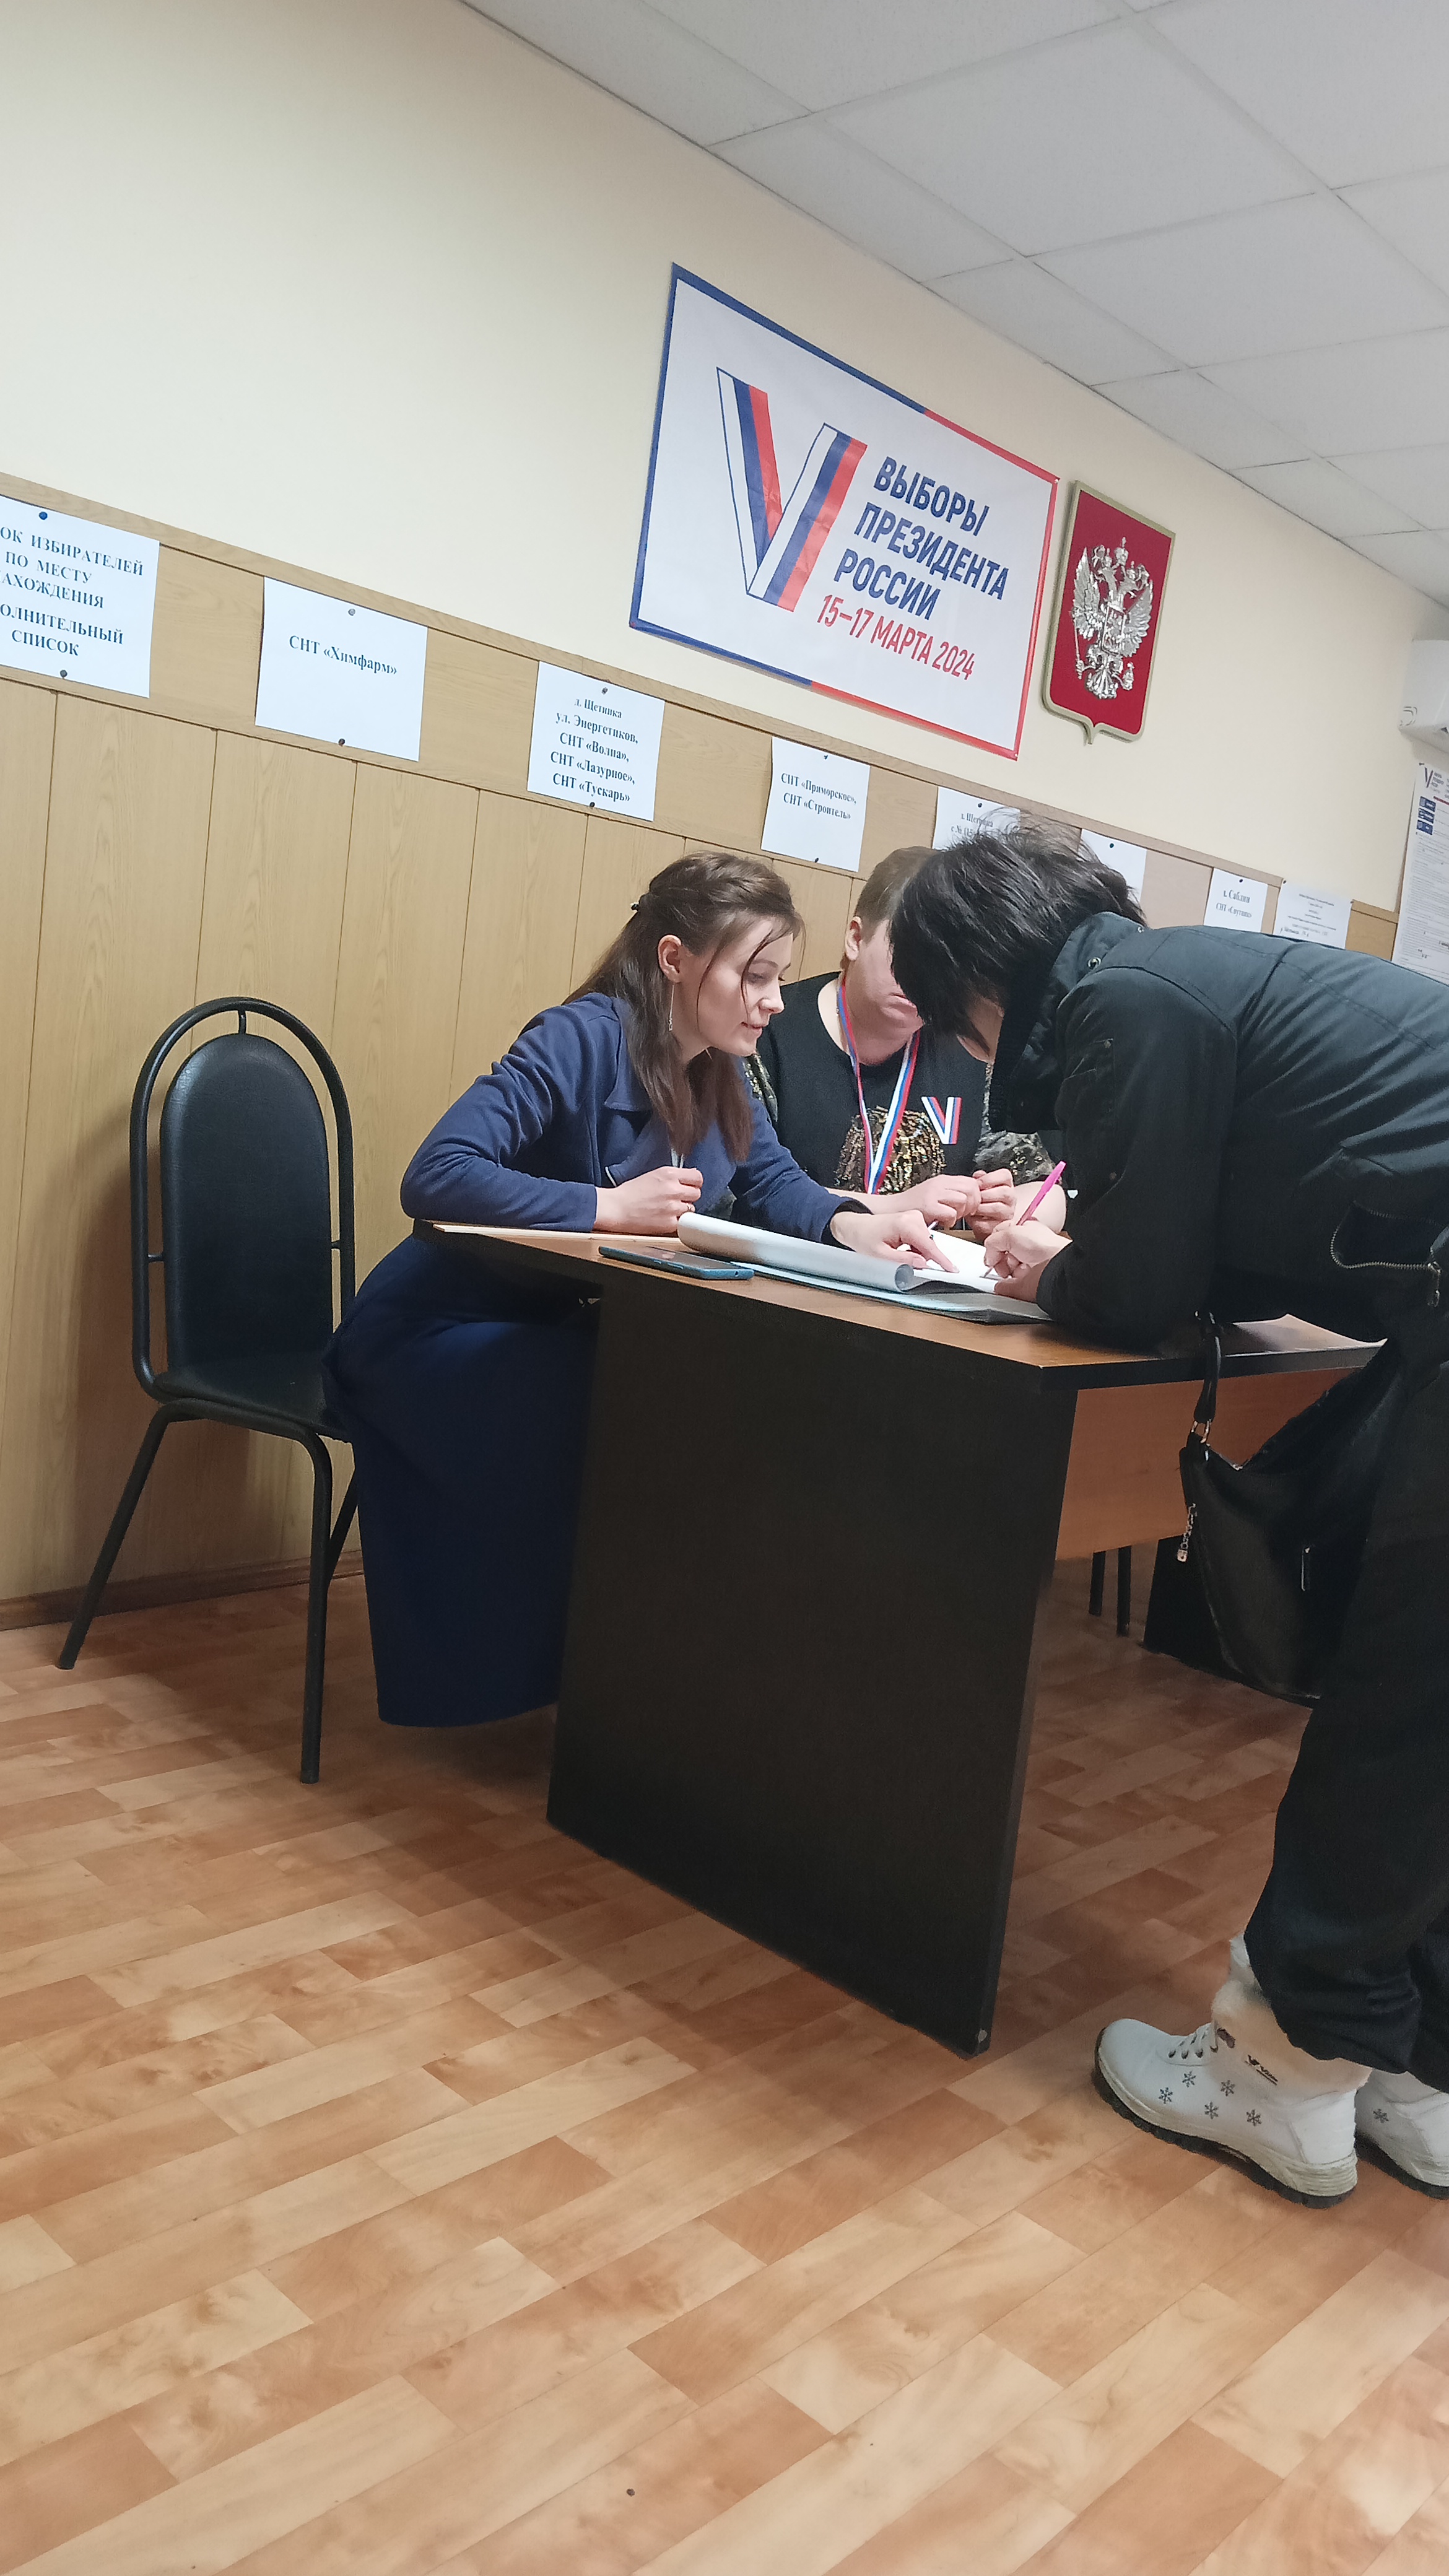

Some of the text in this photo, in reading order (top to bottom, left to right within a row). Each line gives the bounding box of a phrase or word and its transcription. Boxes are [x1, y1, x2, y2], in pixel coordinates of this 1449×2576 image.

[873, 456, 990, 537] ВЫБОРЫ
[6, 551, 92, 584] ПО МЕСТУ
[32, 534, 144, 576] ИЗБИРАТЕЛЕЙ
[854, 502, 1010, 601] ПРЕЗИДЕНТА
[0, 570, 104, 609] АХОЖДЕНИЯ
[833, 548, 941, 620] РОССИИ
[12, 629, 79, 656] СПИСОК
[289, 635, 398, 675] СНТ «Химфарм»
[870, 616, 934, 665] МАРТА
[931, 641, 975, 681] 2024
[584, 698, 622, 719] Щетинка
[555, 712, 639, 744] ул. Энергетиков,
[560, 732, 630, 764] СНТ «Волна»,
[550, 751, 635, 785] СНТ «Лазурное»,
[553, 773, 630, 803] СНТ «Тускарь»
[781, 773, 857, 805] СНТ «Приморское»,
[783, 793, 851, 819] СНТ «Строитель»
